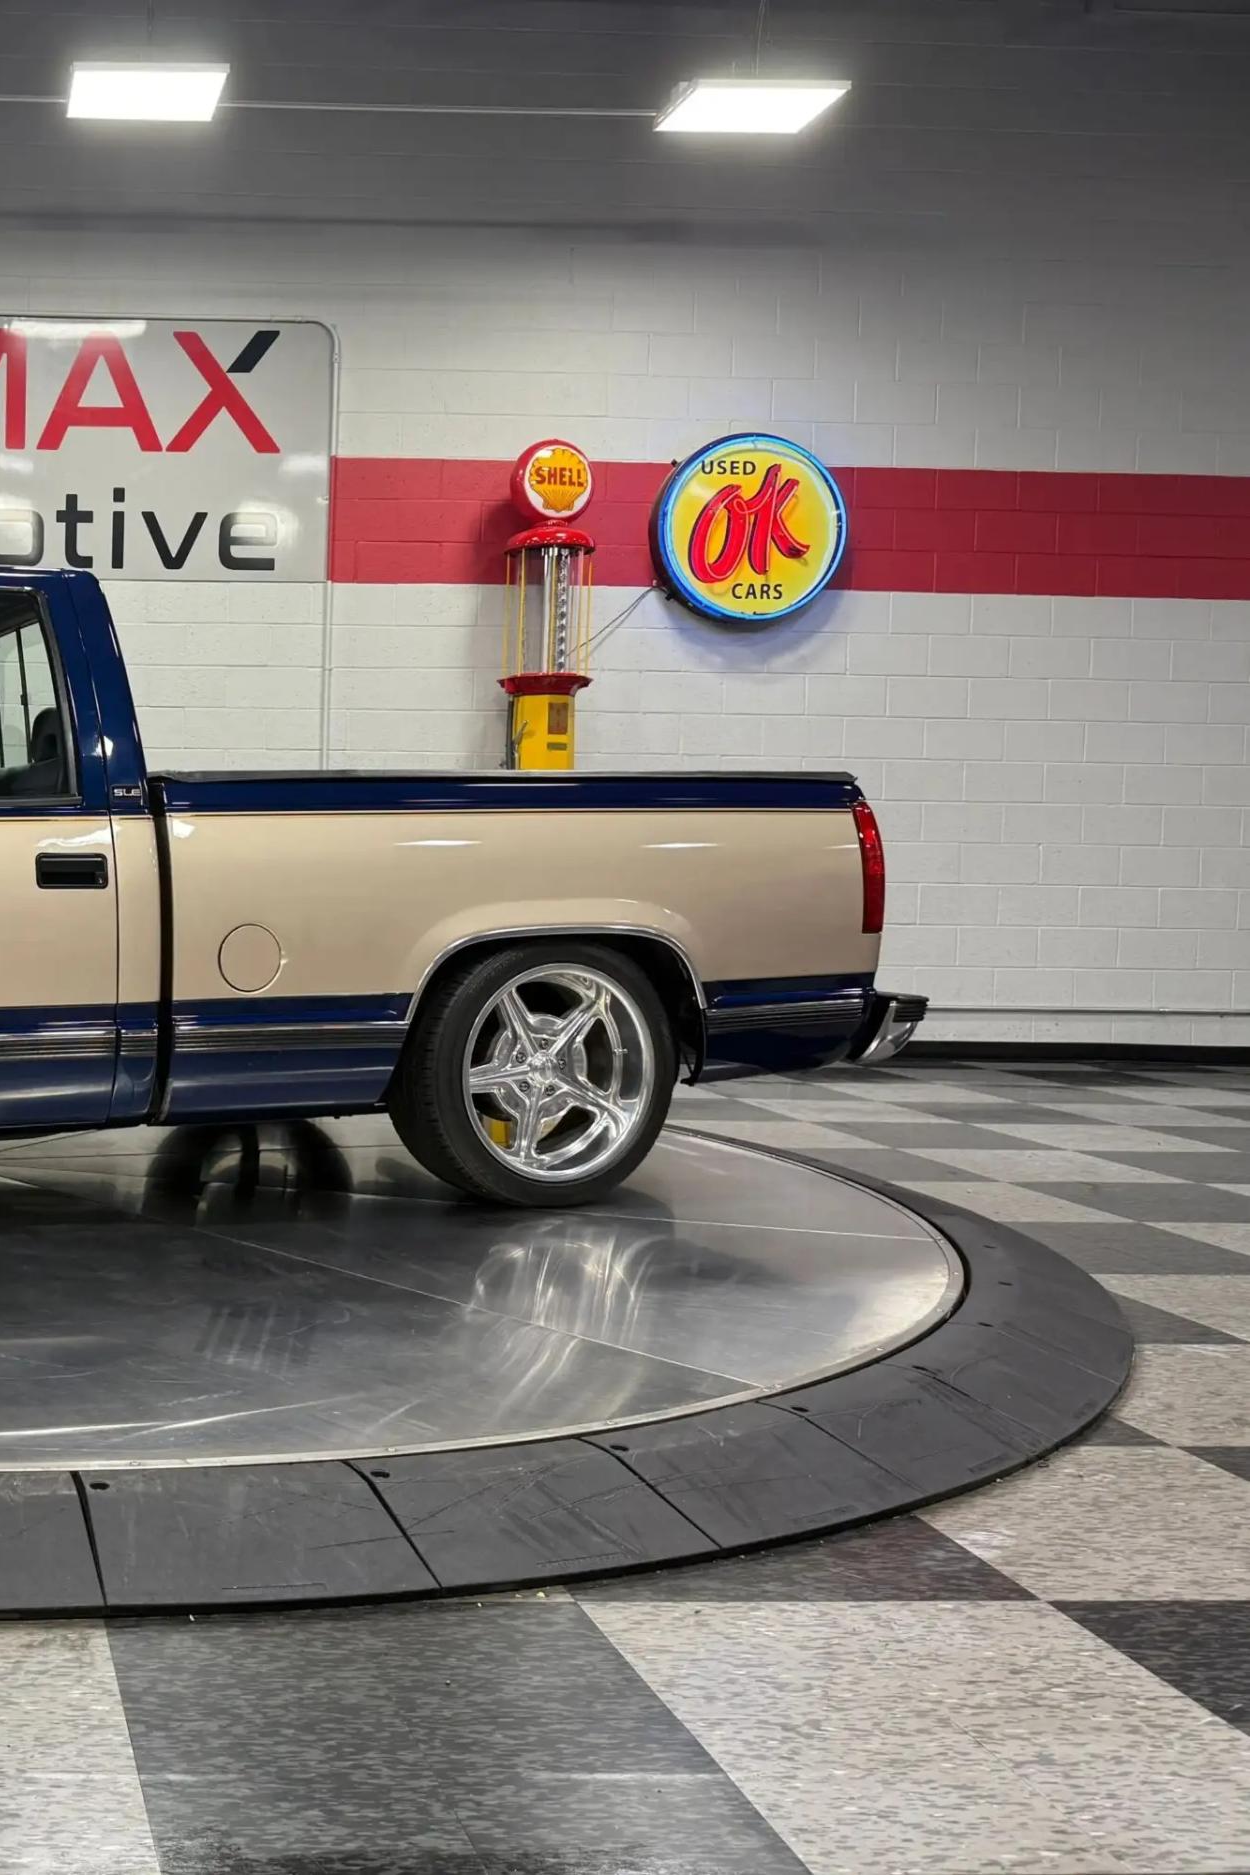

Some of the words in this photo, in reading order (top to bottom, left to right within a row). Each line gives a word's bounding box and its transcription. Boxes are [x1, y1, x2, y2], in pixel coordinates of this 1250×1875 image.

[701, 460, 757, 476] USED
[534, 466, 585, 488] SHELL
[688, 464, 811, 584] OK
[732, 583, 783, 600] CARS
[113, 788, 141, 797] SLE
